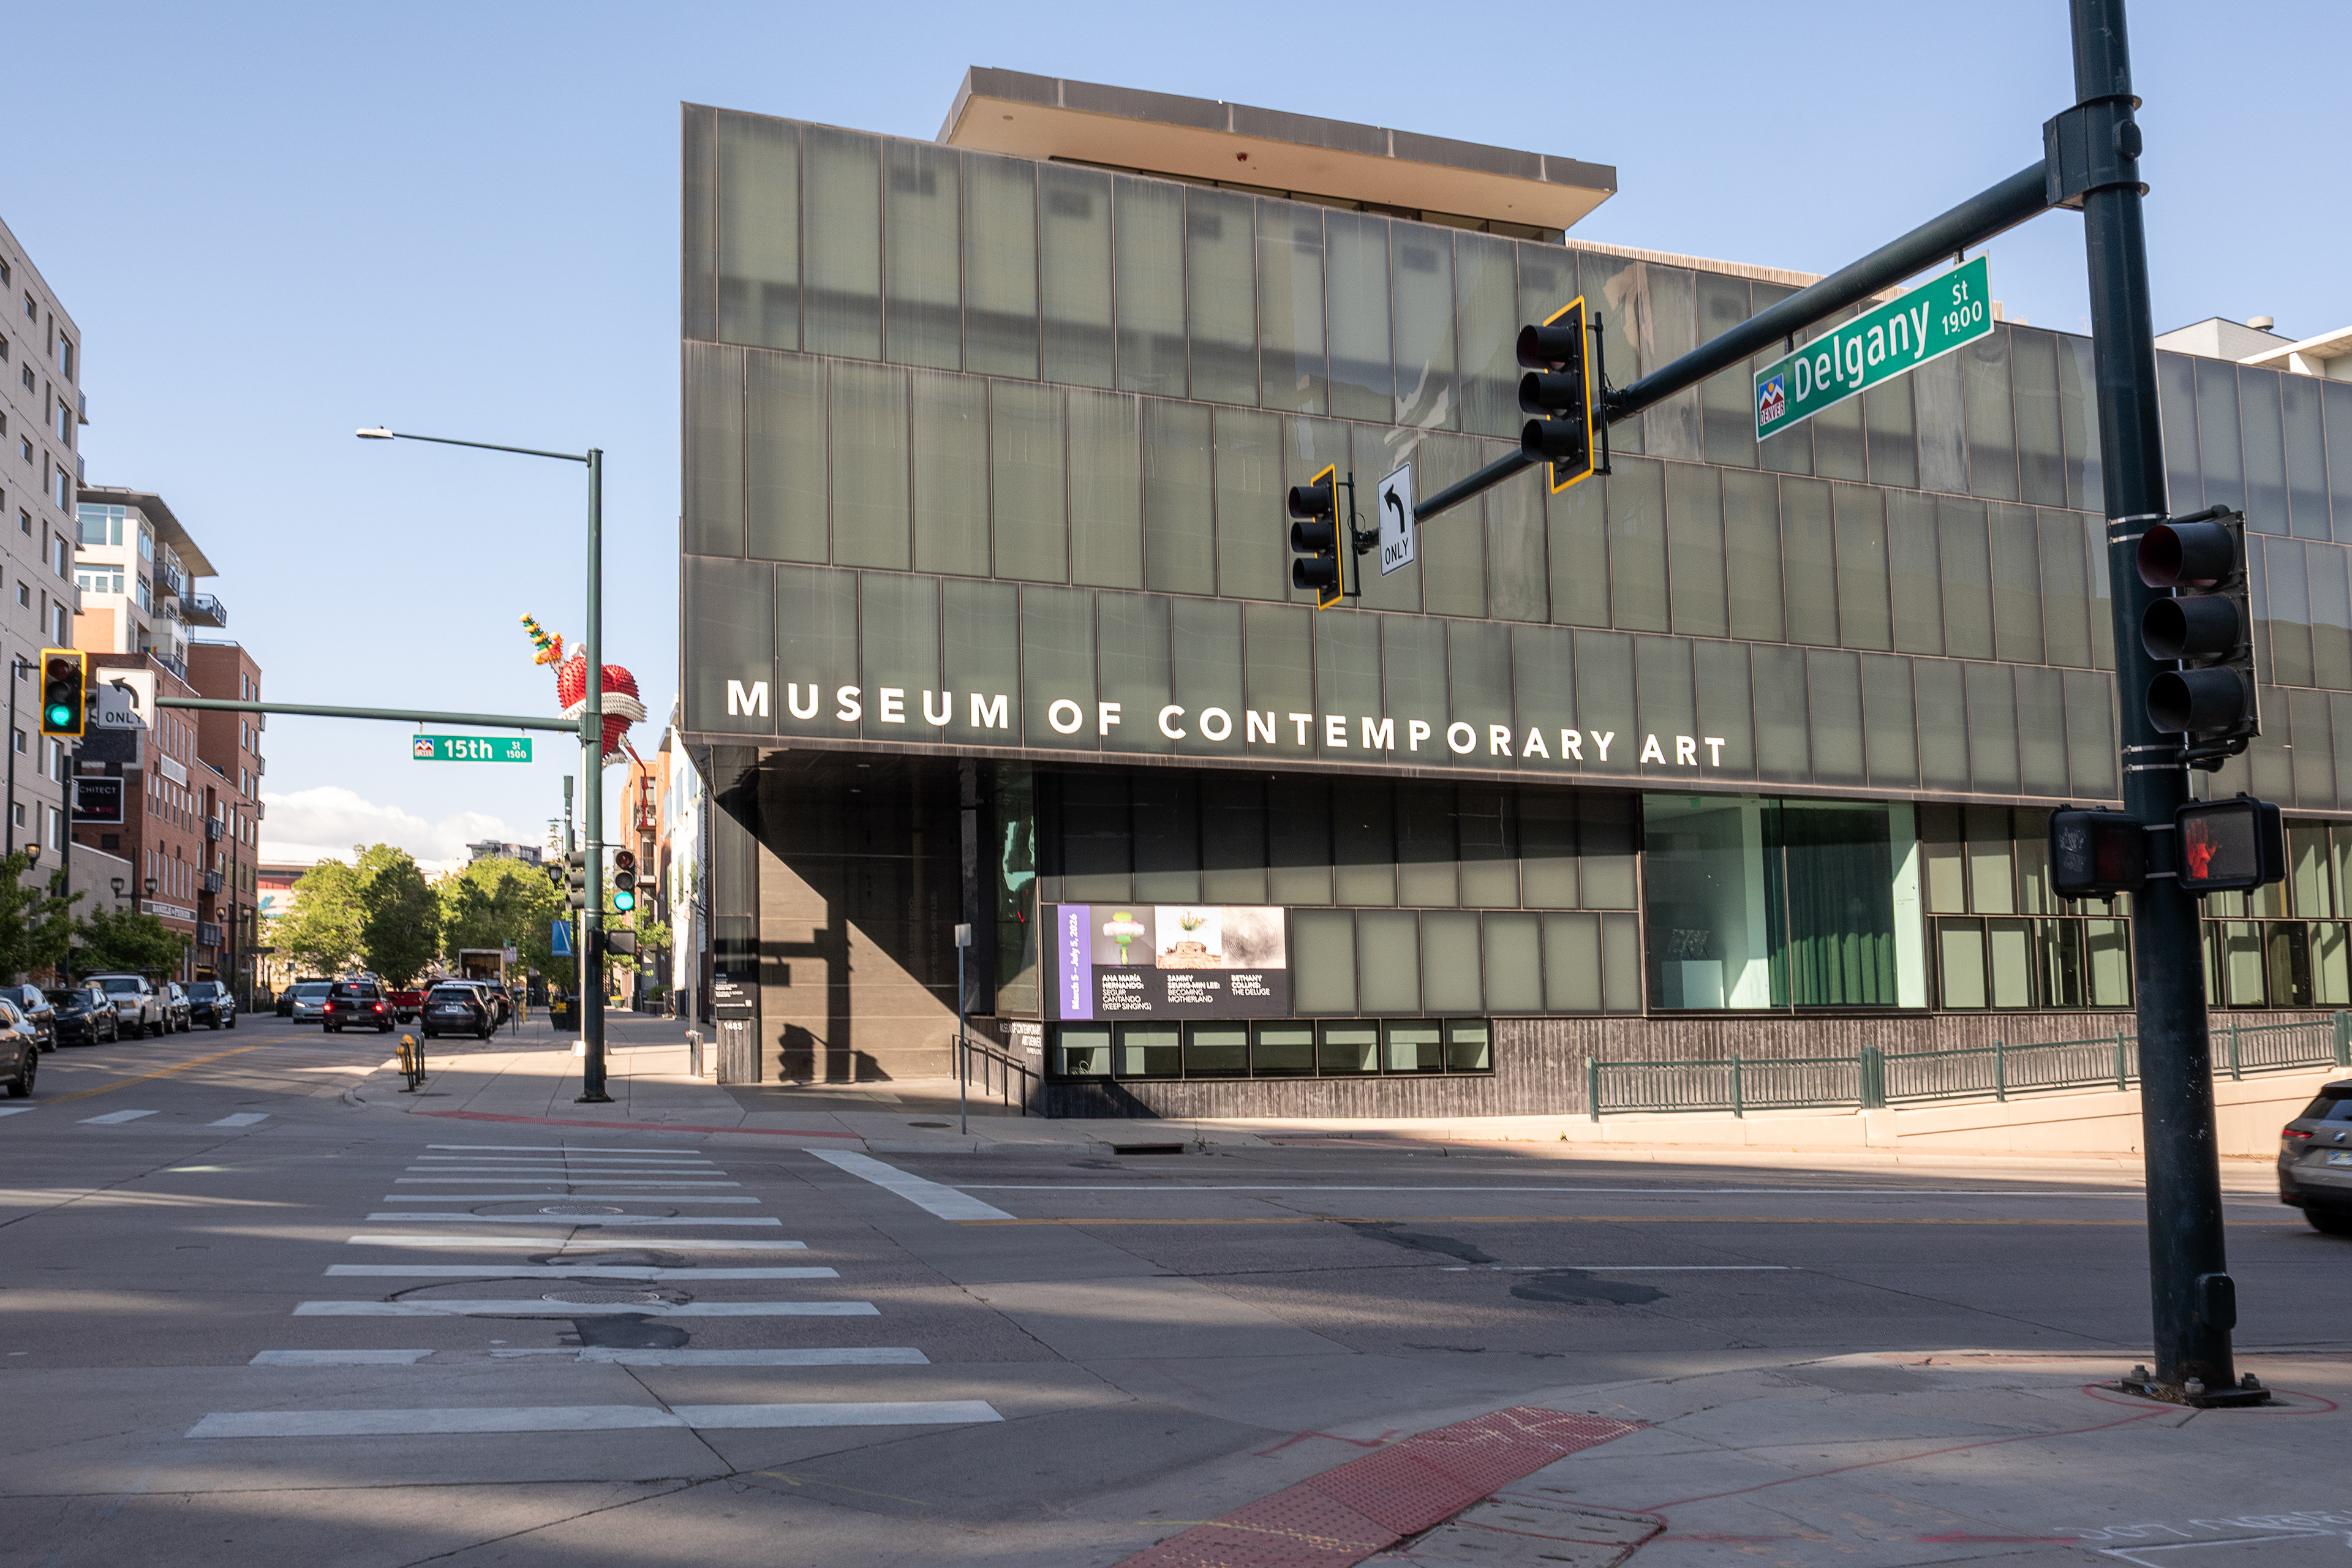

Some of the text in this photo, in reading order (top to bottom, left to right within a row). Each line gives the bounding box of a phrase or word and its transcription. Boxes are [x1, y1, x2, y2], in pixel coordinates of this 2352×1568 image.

[1952, 280, 1969, 305] St
[1942, 300, 1982, 336] 1900
[1795, 301, 1929, 403] Delgany
[1761, 402, 1784, 425] DENVER
[1385, 537, 1409, 565] ONLY
[105, 711, 143, 725] ONLY
[728, 680, 1725, 767] MUSEUM OF CONTEMPORARY ART
[444, 739, 492, 759] 15th
[506, 750, 527, 759] 1500
[511, 741, 521, 750] St
[79, 786, 116, 794] CHITECT
[1069, 913, 1078, 937] 2026
[1069, 937, 1079, 948] 5,
[1070, 948, 1080, 967] July
[1118, 973, 1142, 982] MARÍA
[1071, 982, 1080, 1010] March
[1102, 1002, 1152, 1011] (KEEP SINGING)
